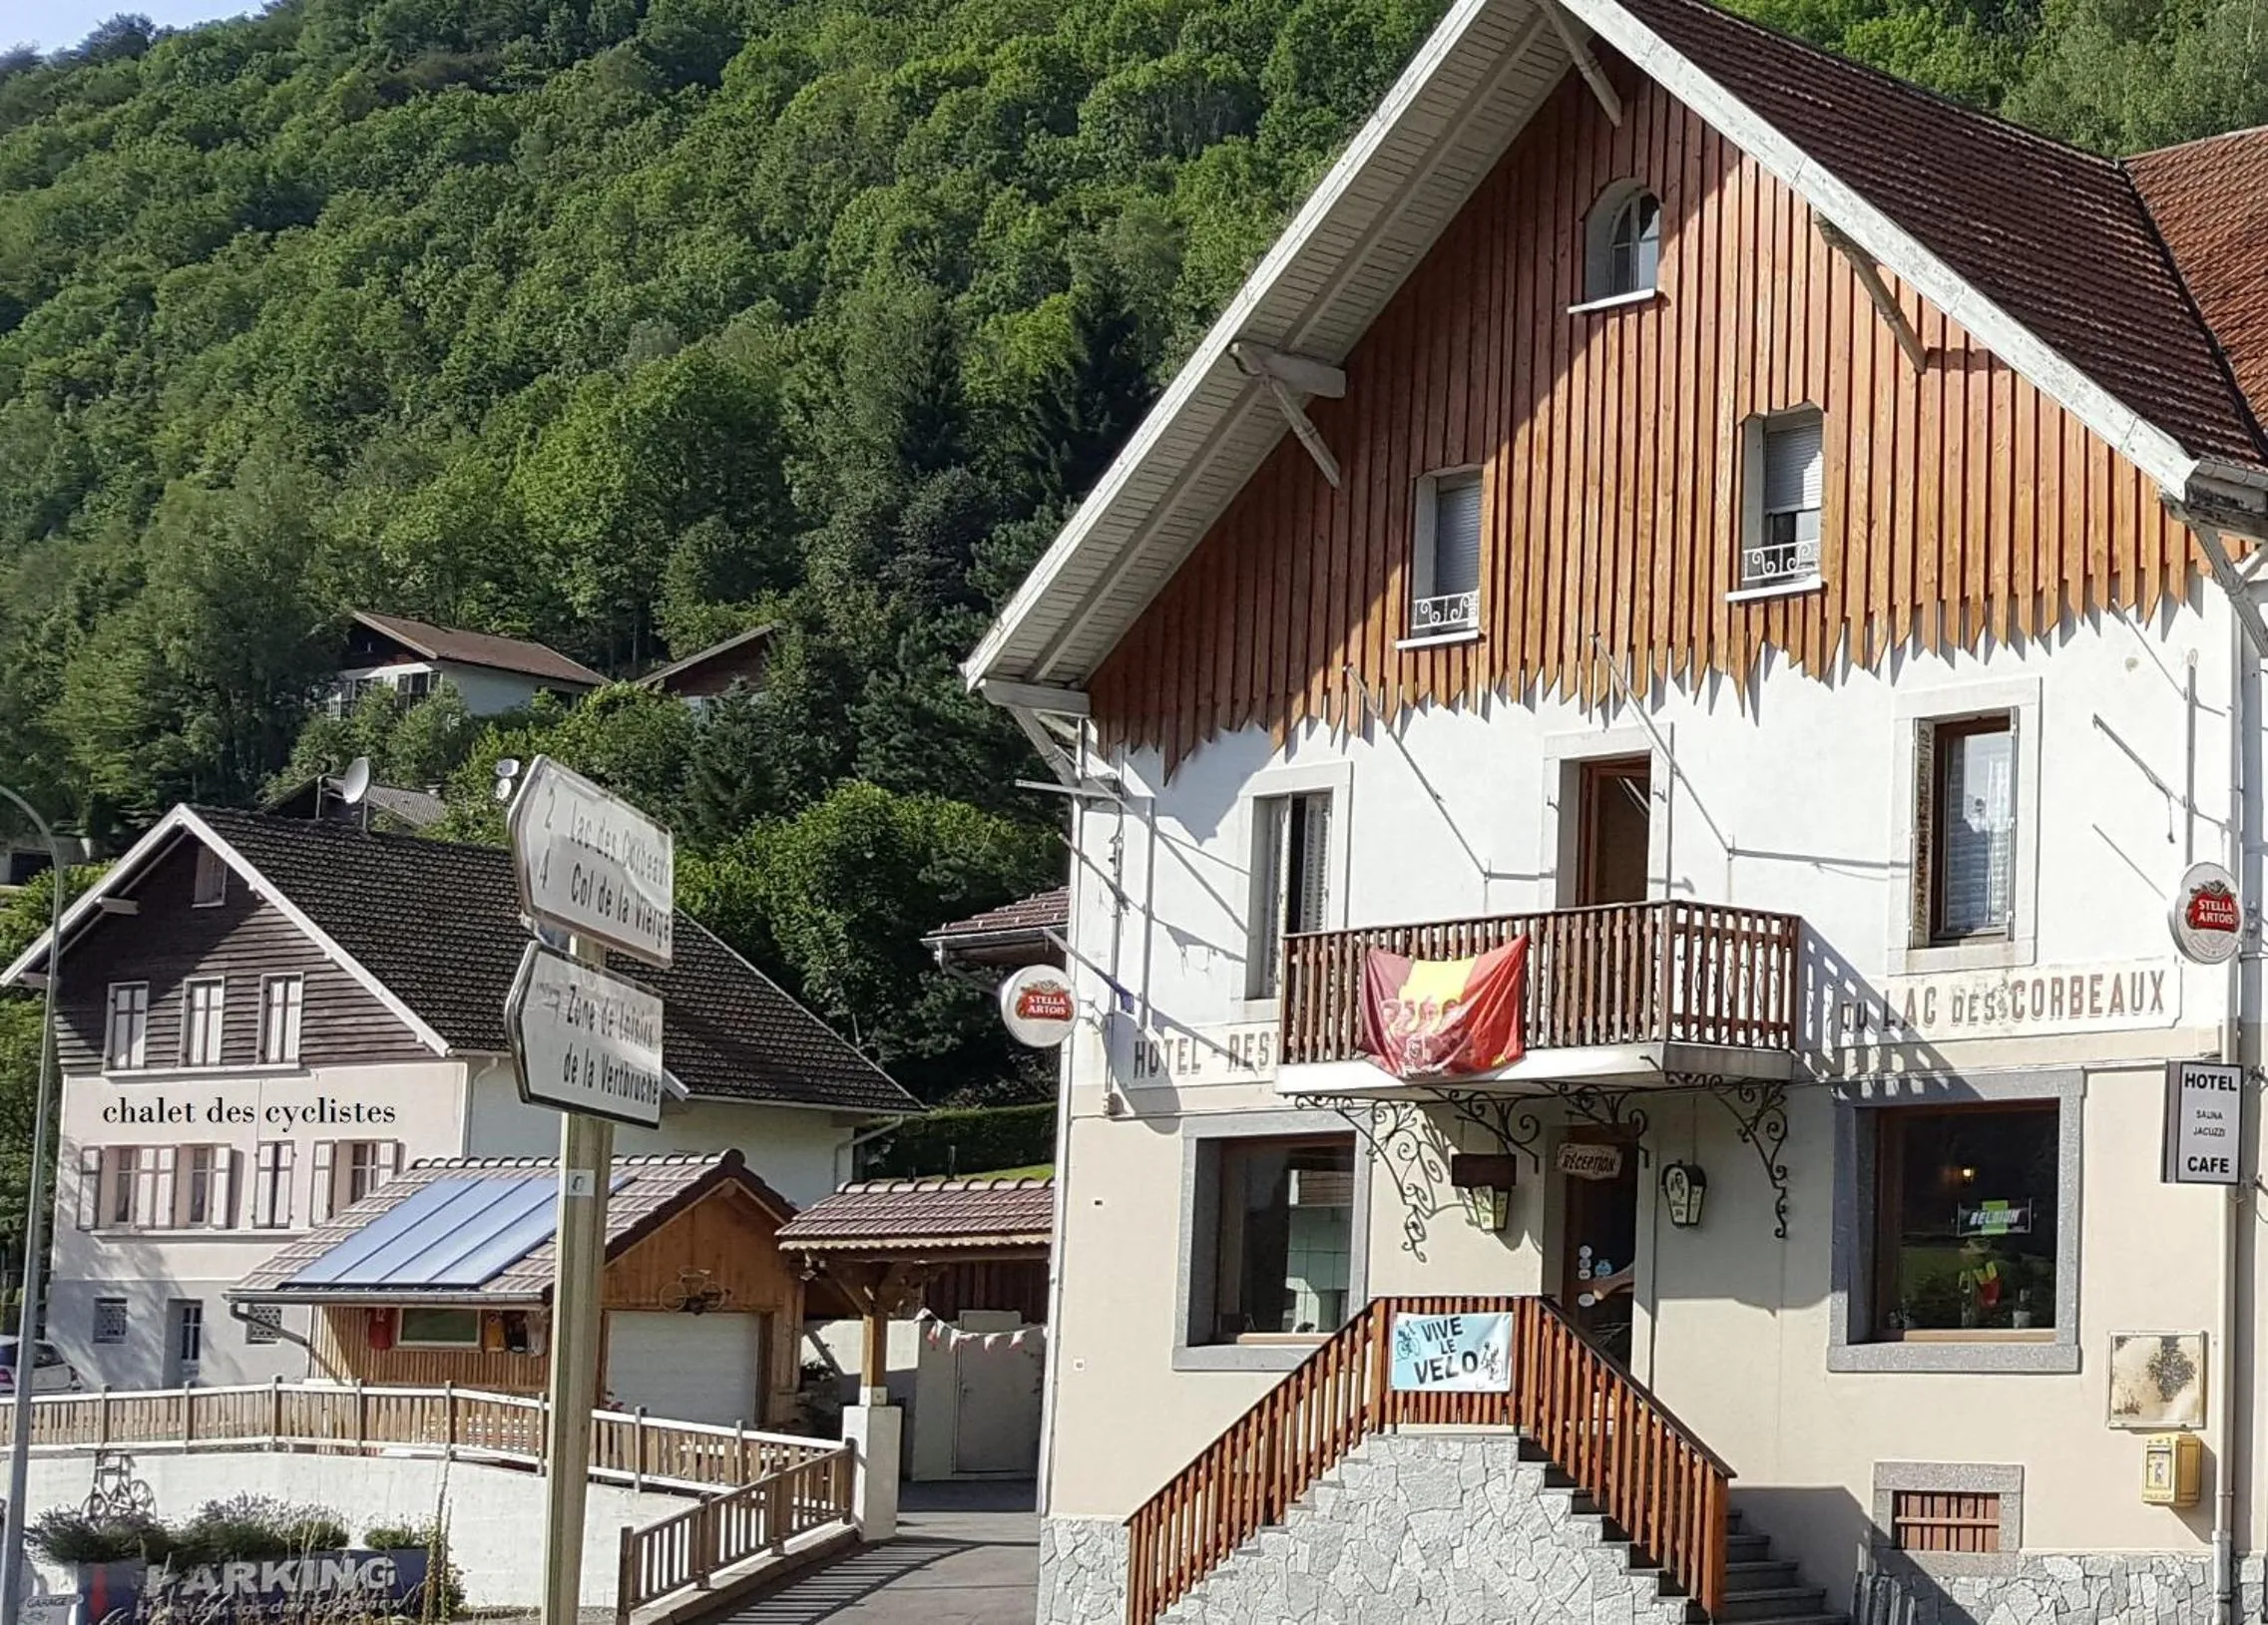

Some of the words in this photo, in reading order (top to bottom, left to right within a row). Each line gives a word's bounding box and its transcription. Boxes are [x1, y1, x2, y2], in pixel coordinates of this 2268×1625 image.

[543, 786, 556, 830] 2
[570, 800, 592, 849] Lac
[597, 816, 617, 863] des
[539, 848, 551, 890] 4
[571, 862, 595, 909] Col
[598, 877, 613, 918] de
[617, 884, 630, 924] la
[636, 890, 671, 949] Vierge
[2198, 898, 2233, 911] STELLA
[2198, 912, 2235, 925] ARTOIS
[566, 984, 596, 1032] Zone
[601, 997, 615, 1037] de
[1027, 1006, 1067, 1016] ARTOIS
[1028, 996, 1066, 1007] STELLA
[1883, 985, 1937, 1033] LAC
[1952, 992, 1996, 1026] DES
[2012, 969, 2165, 1021] CORBEAUX
[563, 1041, 579, 1085] de
[583, 1047, 596, 1089] la
[1134, 1037, 1201, 1078] HOTEL
[2184, 1072, 2237, 1092] HOTEL
[102, 1096, 197, 1124] chalet
[207, 1096, 255, 1124] des
[264, 1096, 396, 1133] cyclistes
[2195, 1109, 2223, 1119] SAUNA
[2193, 1126, 2226, 1137] JACUZZI
[2187, 1156, 2230, 1174] CAFE
[1420, 1316, 1464, 1343] VIVE
[1440, 1338, 1458, 1355] LE
[1413, 1350, 1479, 1386] VELO
[147, 1556, 396, 1597] PARKING
